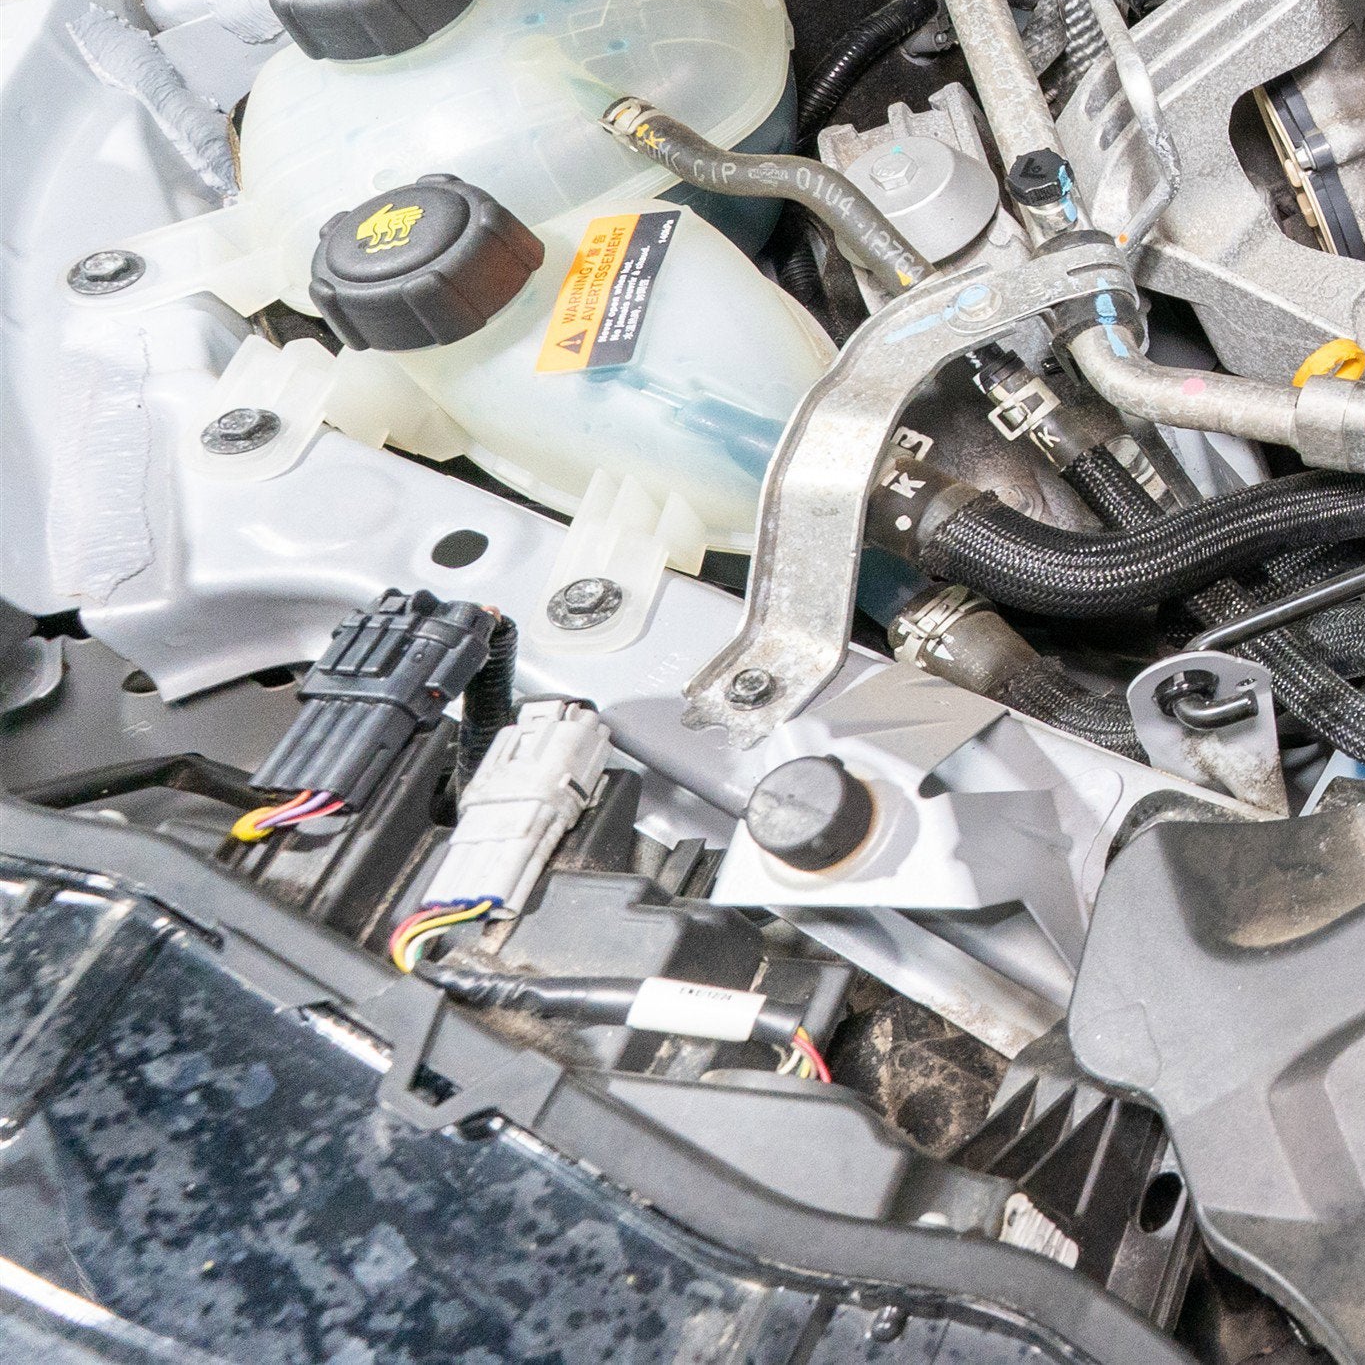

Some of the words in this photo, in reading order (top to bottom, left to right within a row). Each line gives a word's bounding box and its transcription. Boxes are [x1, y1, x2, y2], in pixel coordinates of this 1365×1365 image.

[581, 227, 625, 320] AVERTISSEMENT
[613, 274, 627, 295] when
[562, 267, 593, 323] WARNING
[608, 296, 620, 317] open
[614, 301, 630, 327] jamais
[624, 277, 637, 300] ouvrir
[597, 319, 613, 342] Never
